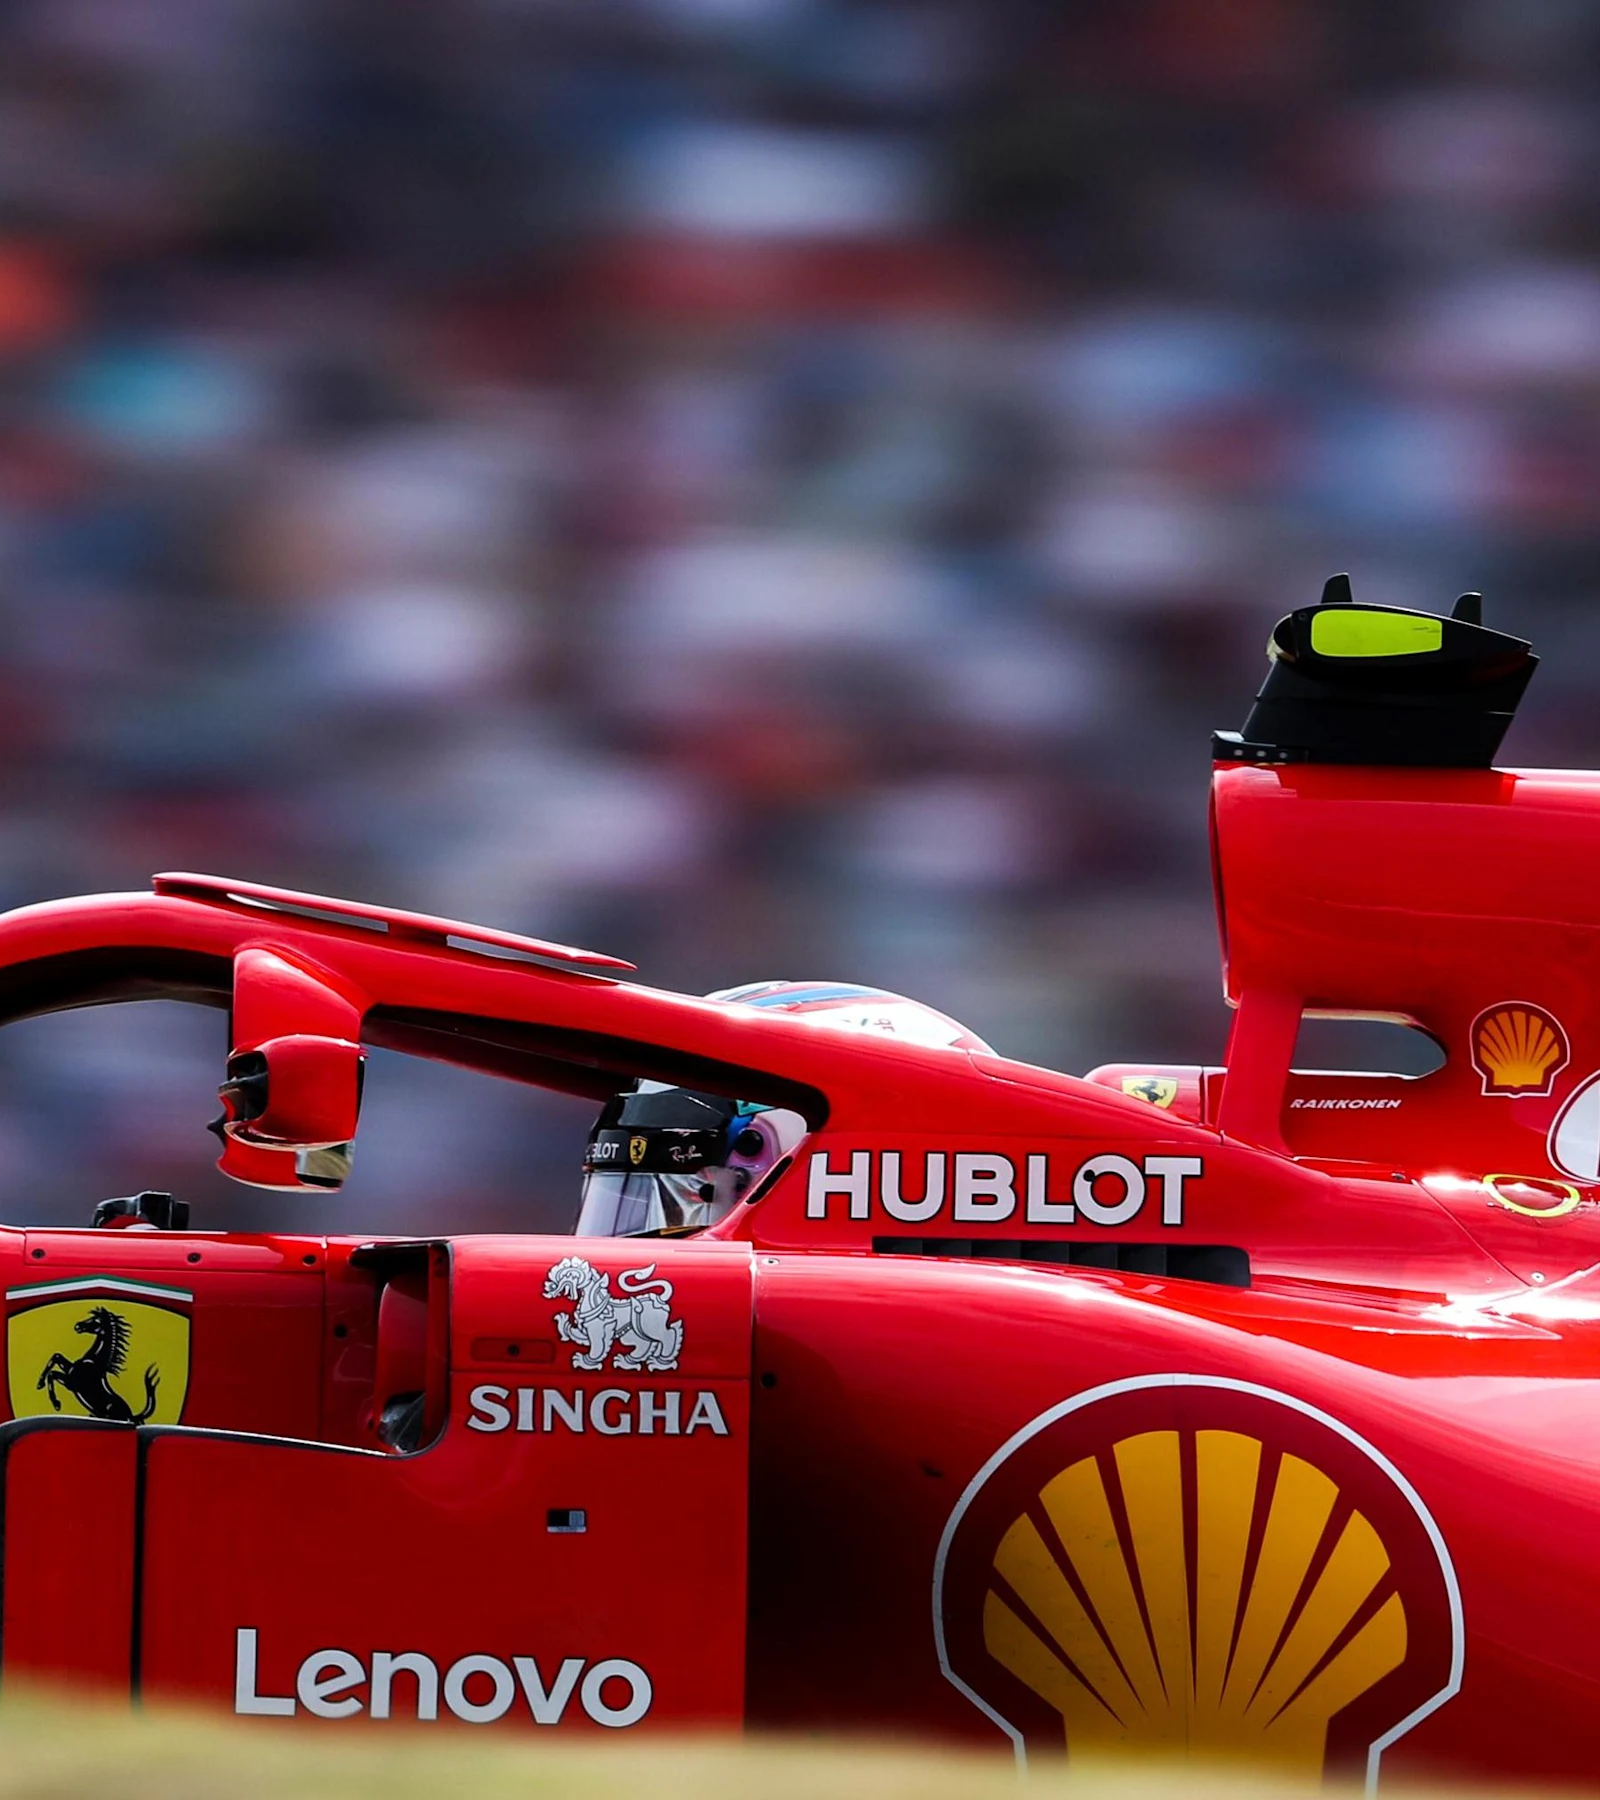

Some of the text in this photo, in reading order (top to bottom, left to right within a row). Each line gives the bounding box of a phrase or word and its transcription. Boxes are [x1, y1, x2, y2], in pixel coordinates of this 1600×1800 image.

[1289, 1099, 1402, 1109] RAIKKONEN
[806, 1151, 1202, 1226] HUBLOT
[467, 1385, 729, 1435] SINGHA
[235, 1628, 653, 1728] Lenovo
